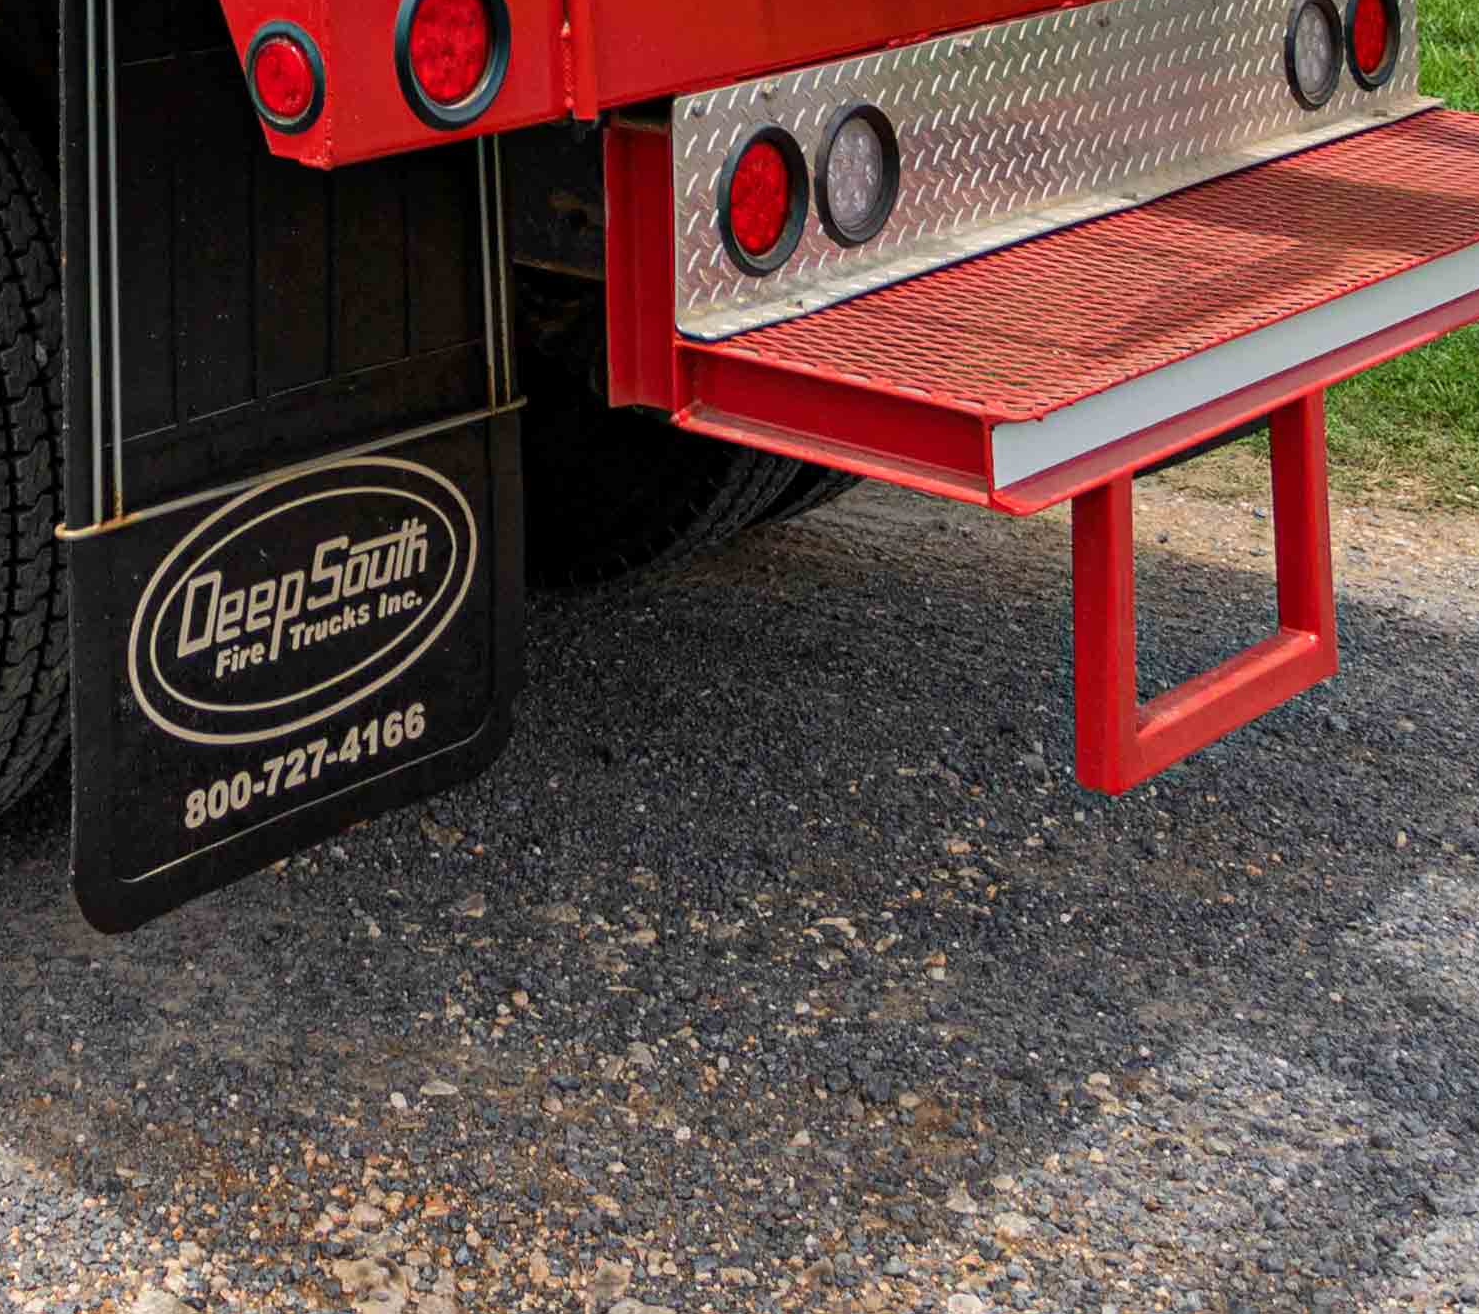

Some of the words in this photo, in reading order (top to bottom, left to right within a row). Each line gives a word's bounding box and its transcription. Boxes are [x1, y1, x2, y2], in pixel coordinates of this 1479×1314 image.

[177, 571, 305, 659] Deep
[307, 518, 428, 607] South
[215, 641, 265, 678] Fire
[288, 602, 371, 651] Trucks
[377, 591, 423, 620] Inc.
[184, 703, 426, 828] 800-727-4166
